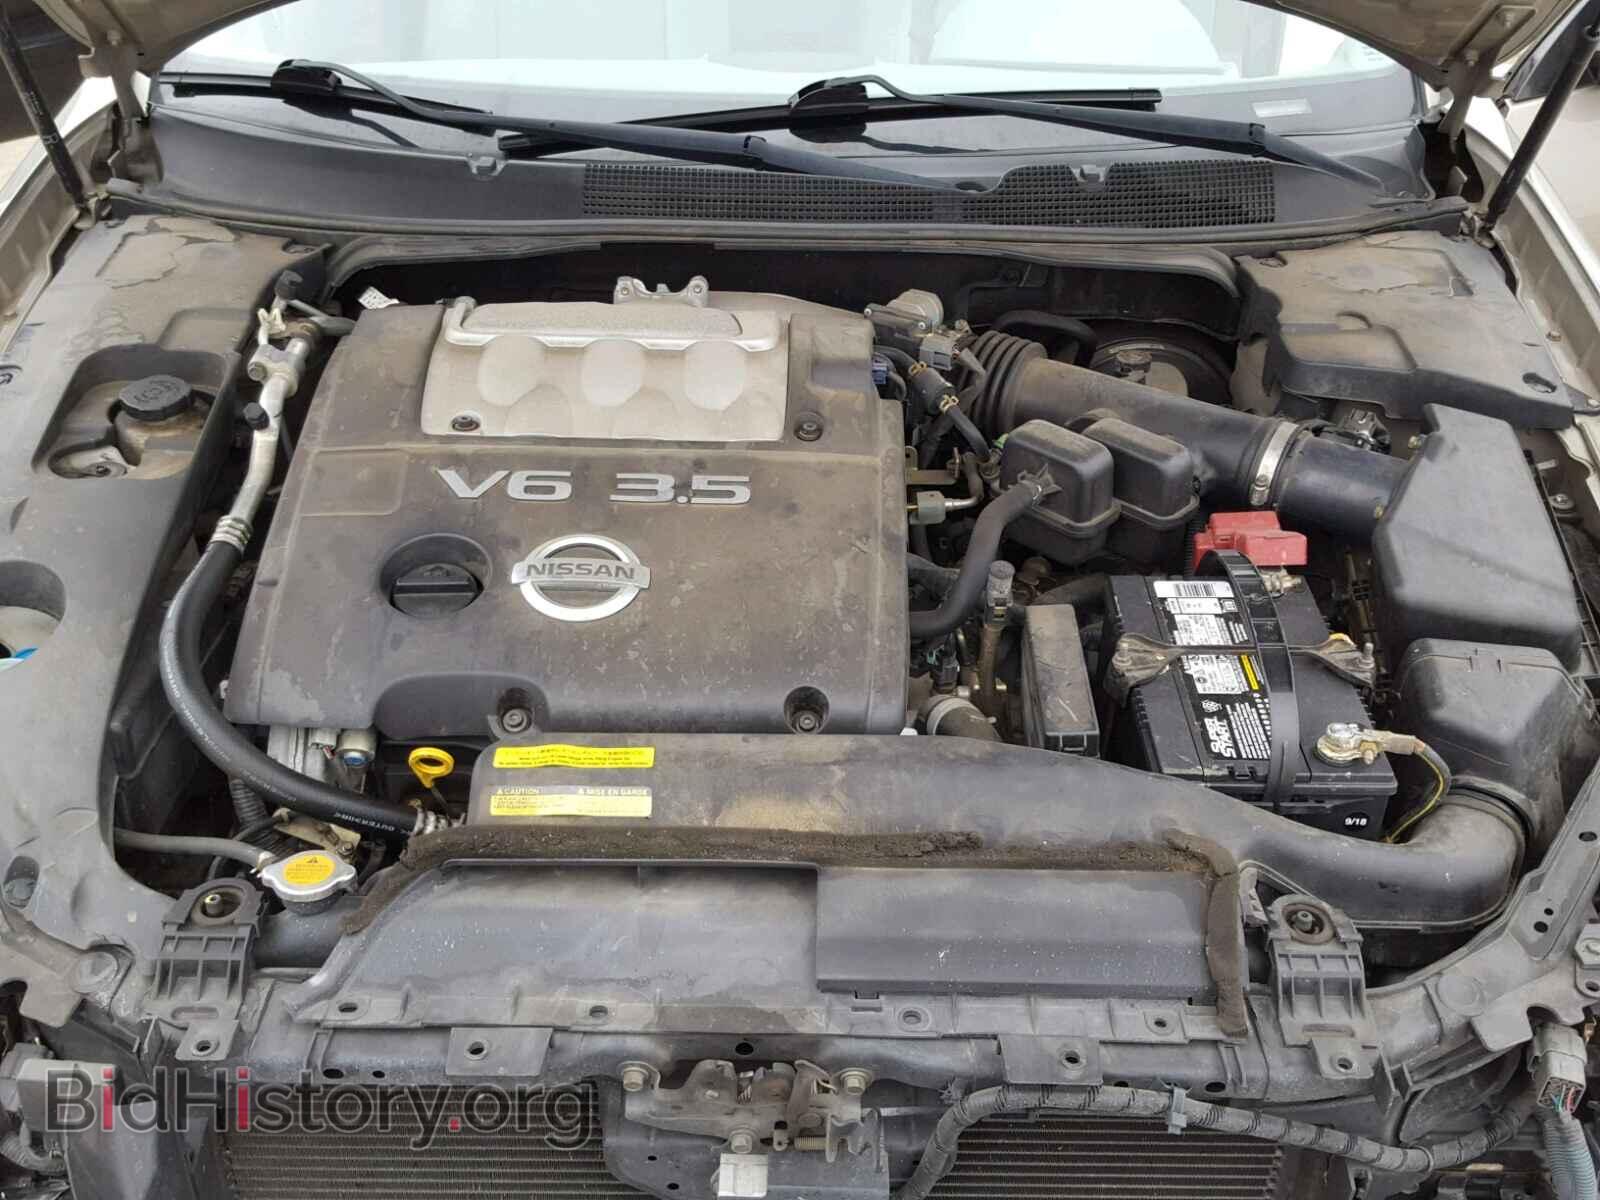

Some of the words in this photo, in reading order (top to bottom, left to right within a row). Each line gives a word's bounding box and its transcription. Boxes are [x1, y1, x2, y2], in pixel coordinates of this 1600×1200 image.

[436, 469, 573, 501] V6
[609, 472, 751, 504] 3.5
[526, 562, 635, 580] NISSAN
[1204, 715, 1221, 753] SUPER
[503, 787, 540, 796] CAUTION
[1344, 817, 1368, 826] 9/18
